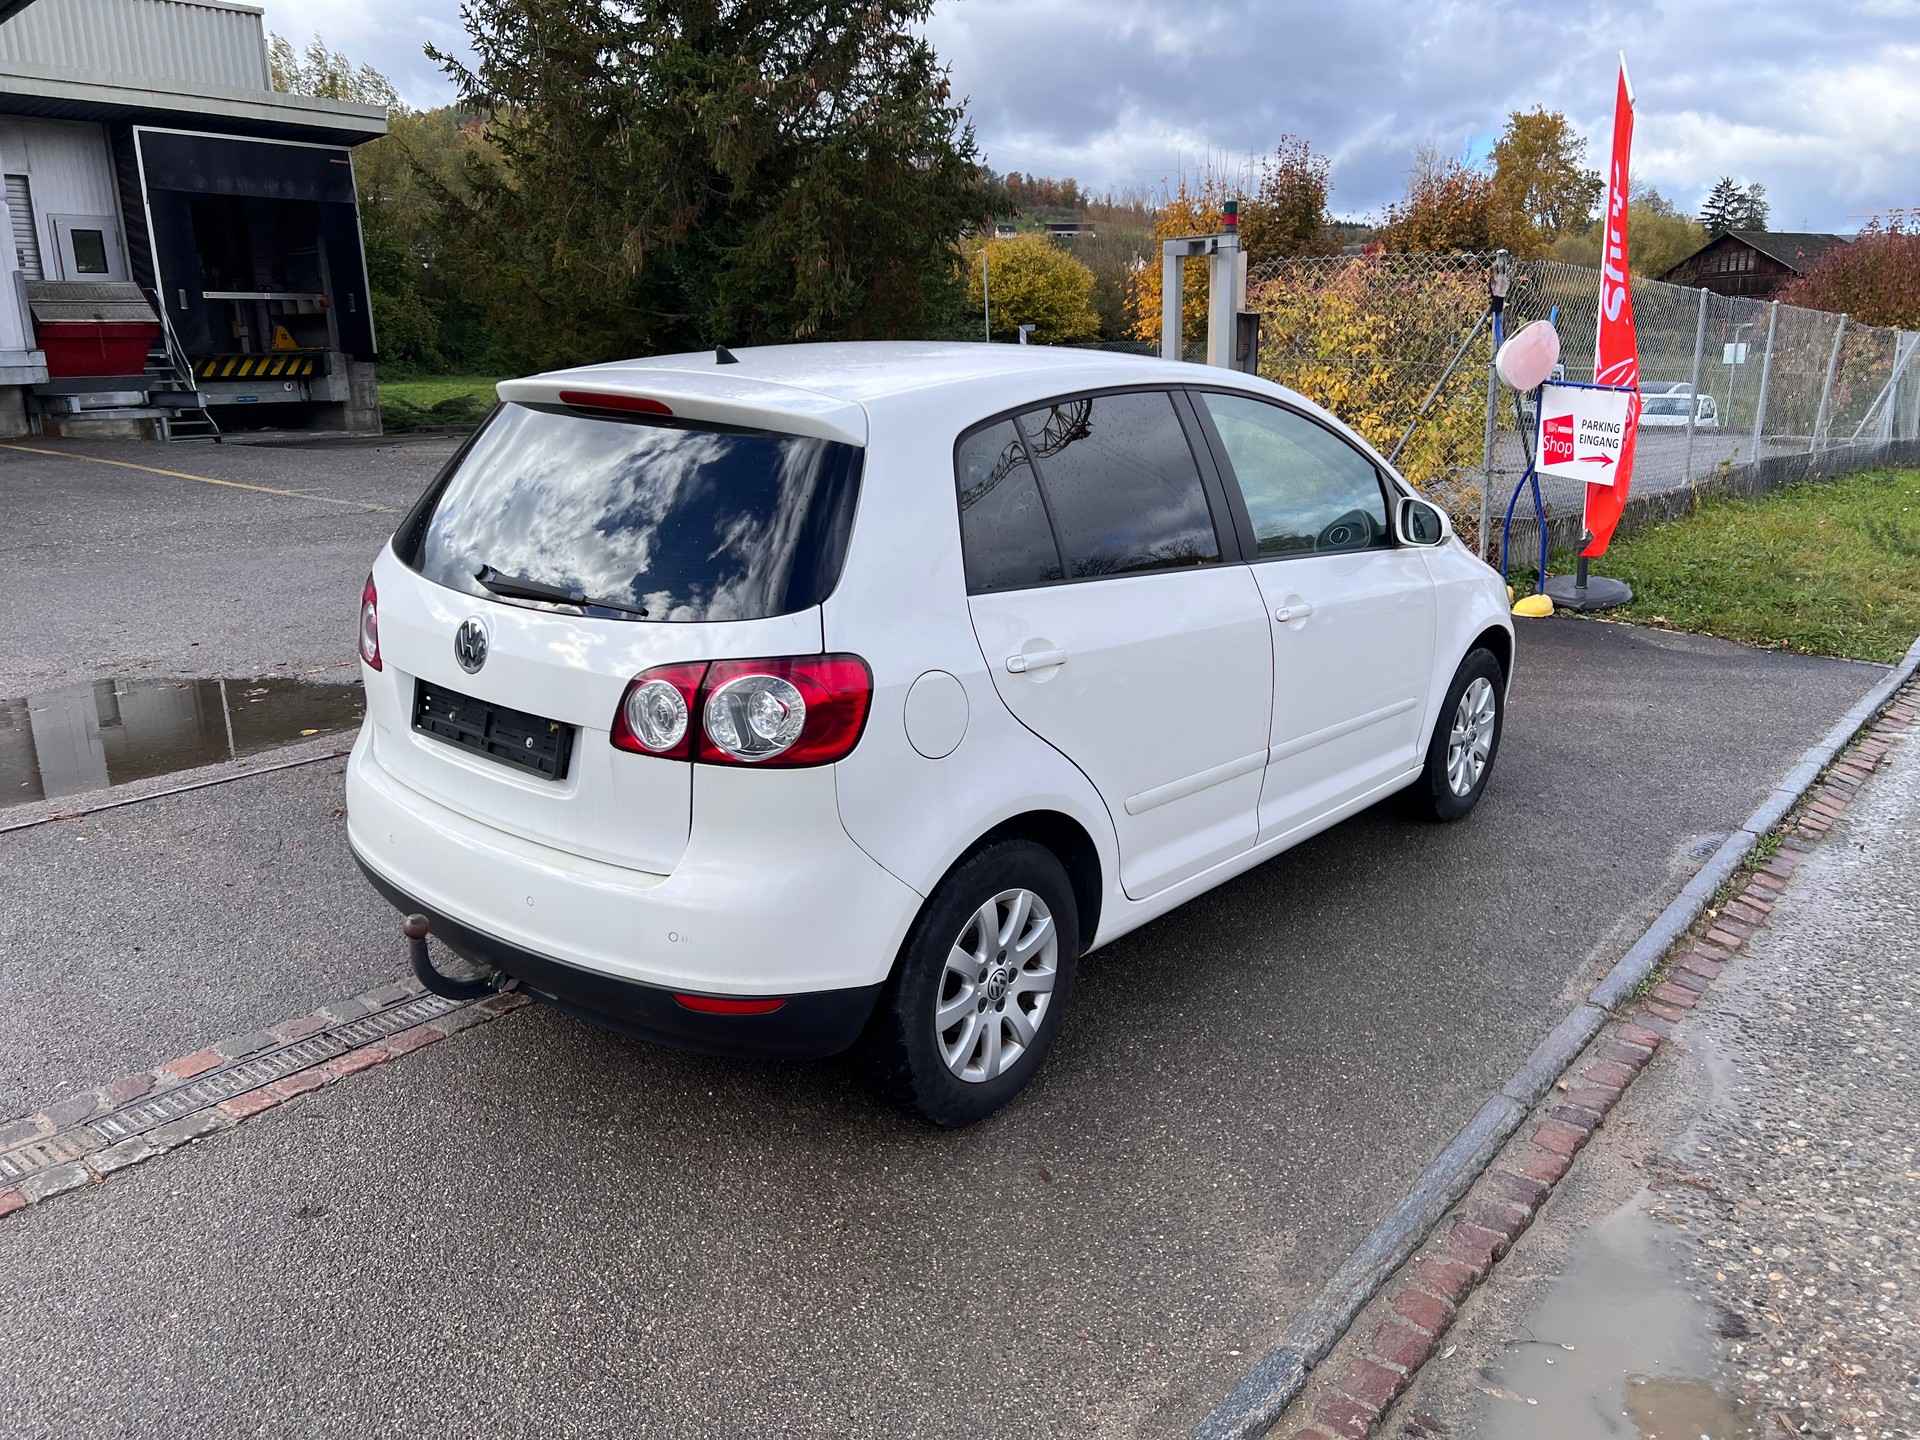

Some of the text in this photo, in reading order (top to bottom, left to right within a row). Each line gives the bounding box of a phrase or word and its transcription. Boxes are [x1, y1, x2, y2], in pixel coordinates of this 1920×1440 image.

[1581, 419, 1620, 433] PARKING
[1543, 435, 1572, 458] Shop
[1579, 434, 1619, 448] EINGANG
